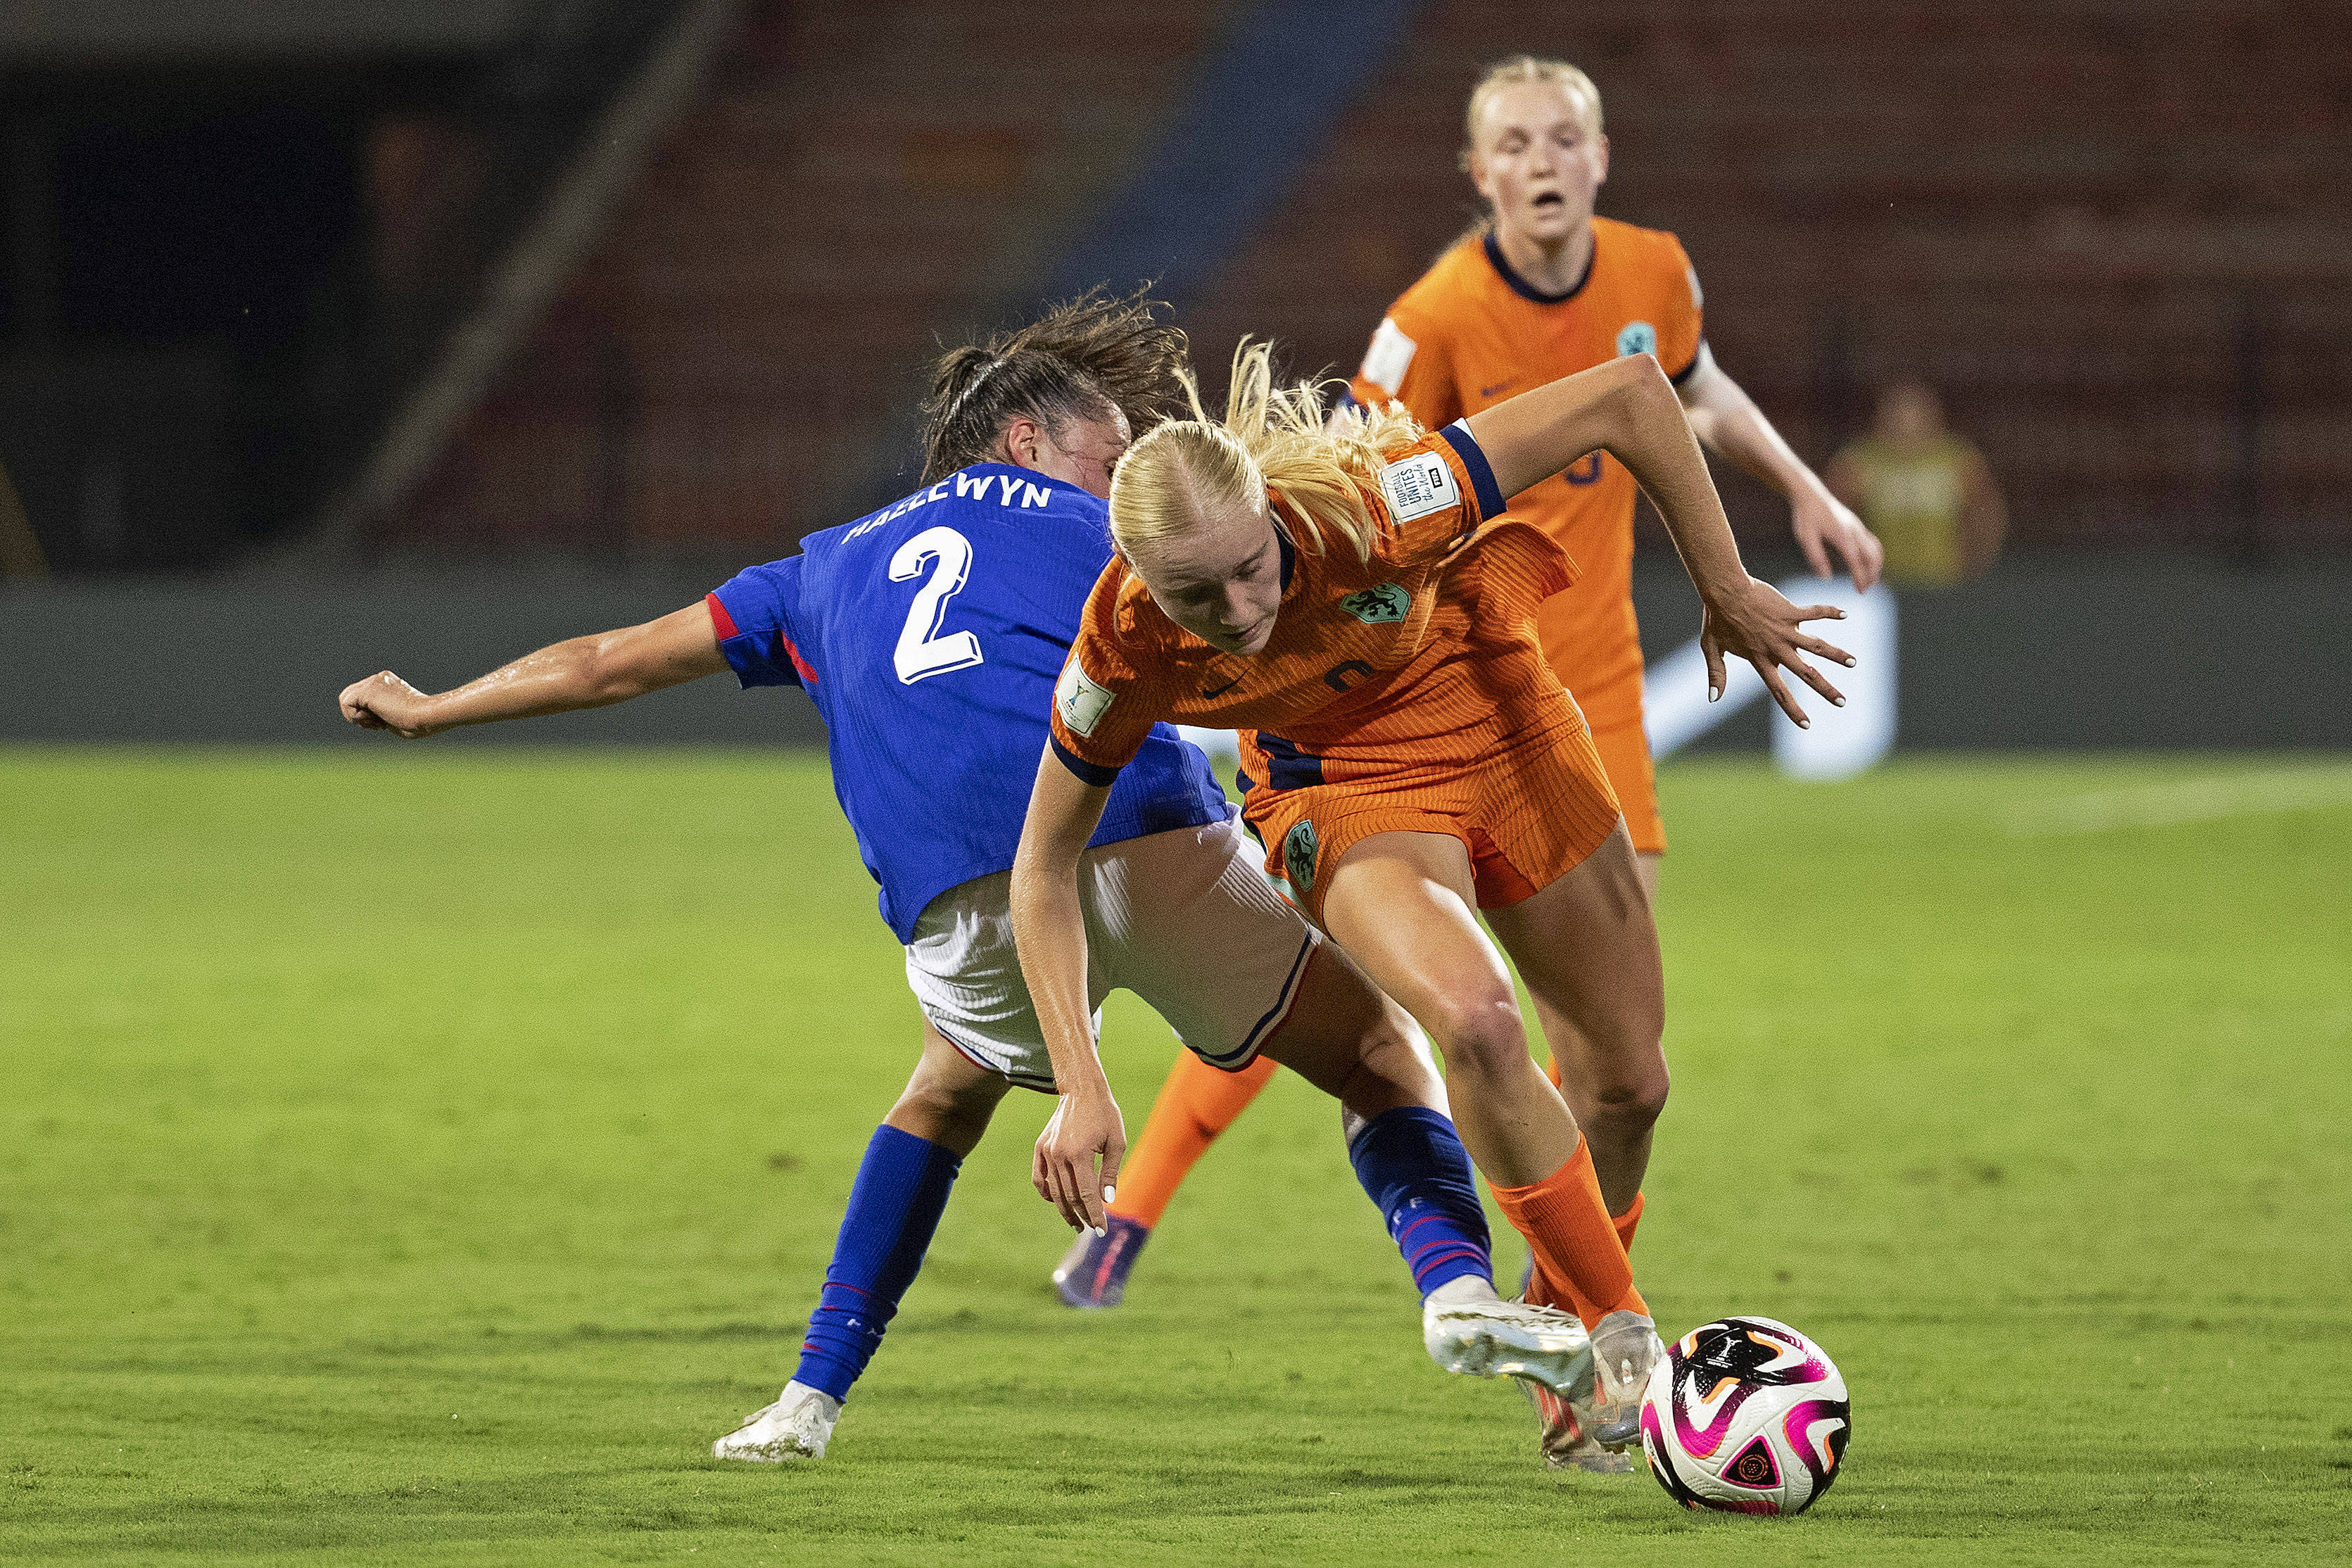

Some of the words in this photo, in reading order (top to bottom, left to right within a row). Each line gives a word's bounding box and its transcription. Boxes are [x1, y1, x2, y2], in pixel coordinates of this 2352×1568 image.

[1391, 472, 1409, 508] FOOTBALL
[1400, 468, 1422, 505] UNITES
[1413, 463, 1429, 487] World
[1422, 487, 1434, 502] the
[888, 526, 985, 686] 2
